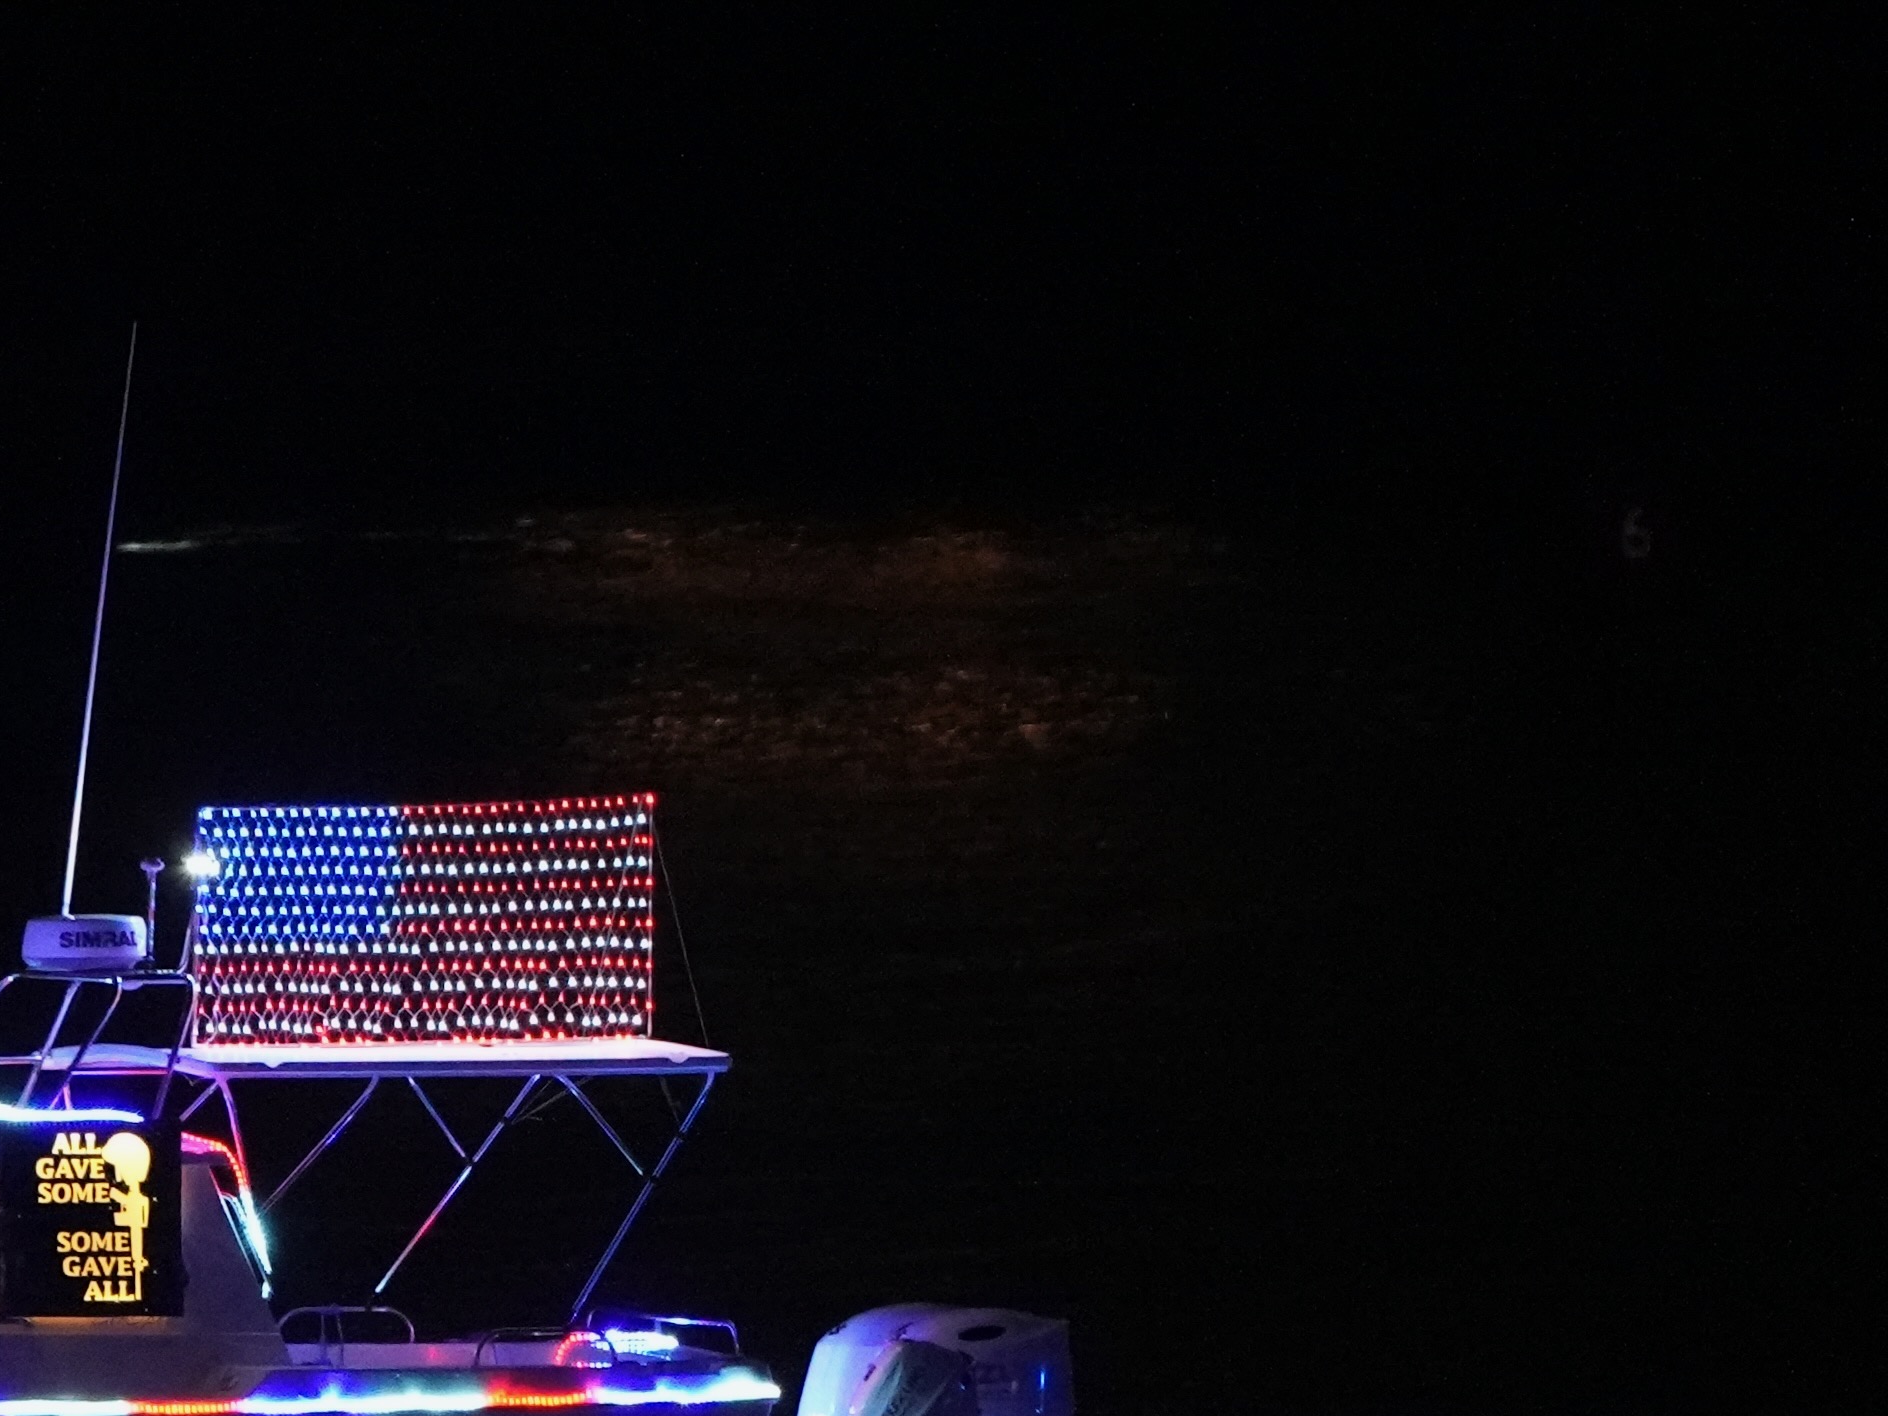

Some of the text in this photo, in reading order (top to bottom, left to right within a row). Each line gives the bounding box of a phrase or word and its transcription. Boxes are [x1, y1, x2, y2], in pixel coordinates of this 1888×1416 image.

[1621, 506, 1652, 559] 6
[52, 1132, 103, 1155] ALL
[34, 1157, 106, 1180] GAVE
[36, 1182, 112, 1204] SOME
[56, 1231, 131, 1253] SOME
[62, 1256, 134, 1278] GAVE
[82, 1280, 136, 1303] ALL
